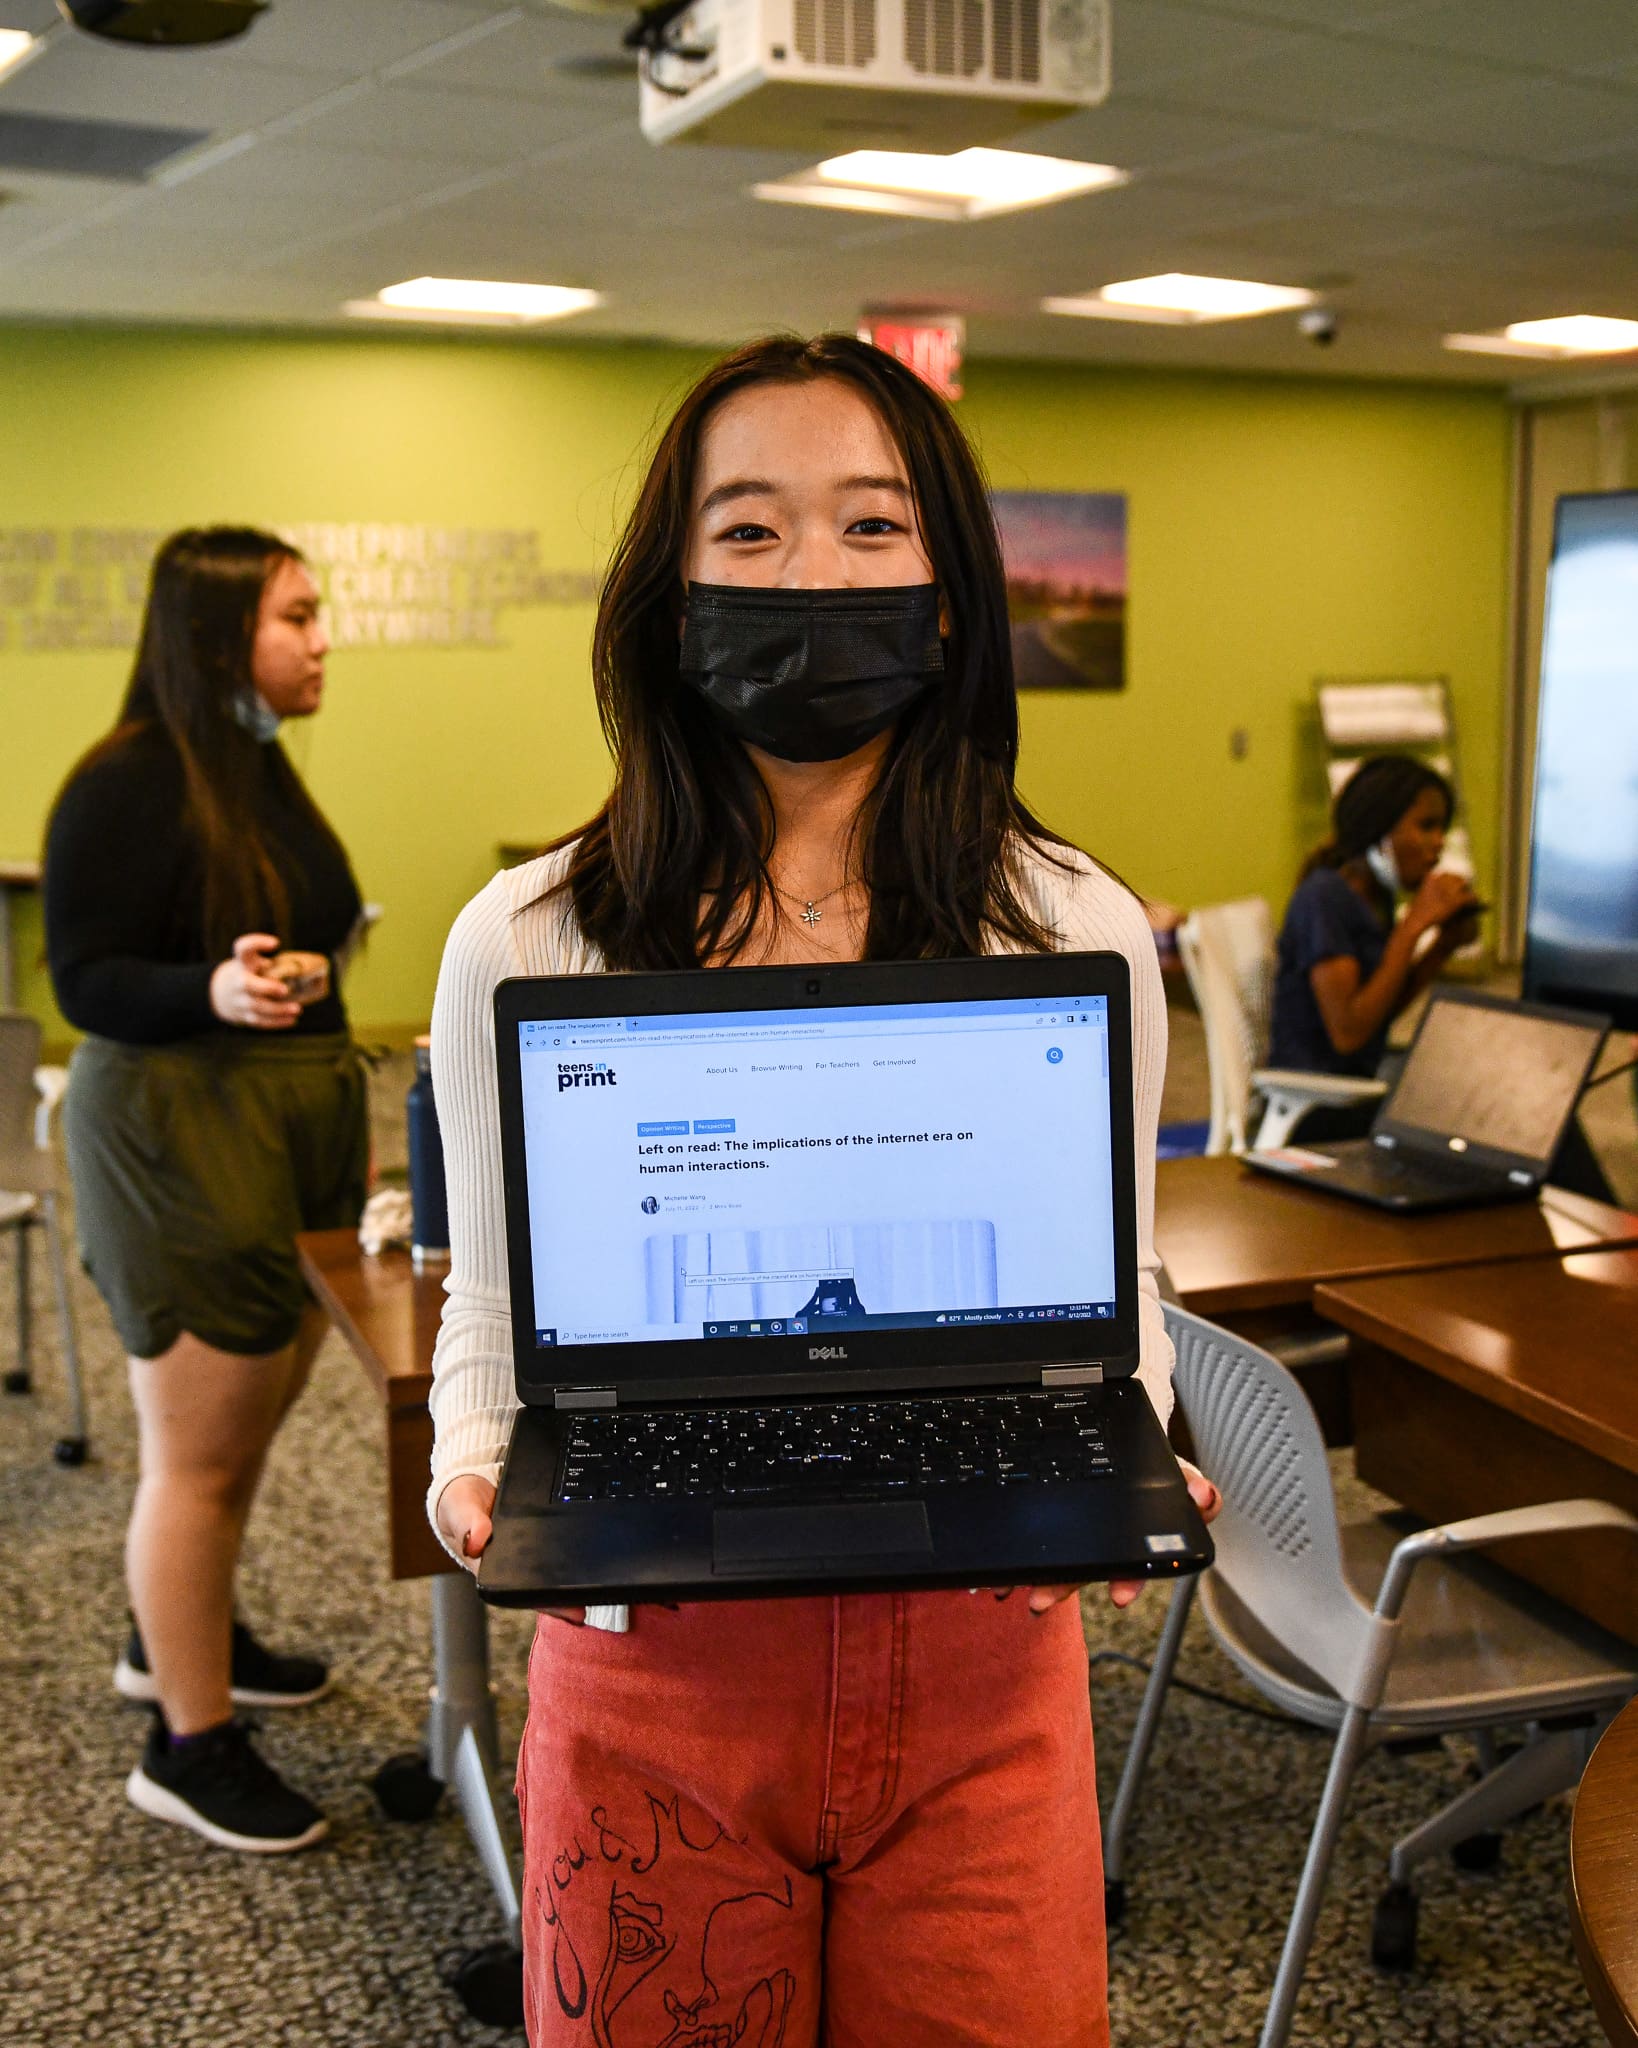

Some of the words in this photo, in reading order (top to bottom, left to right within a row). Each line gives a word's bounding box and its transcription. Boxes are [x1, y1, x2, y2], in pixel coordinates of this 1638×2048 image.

[830, 1061, 860, 1069] Teachers
[887, 1058, 917, 1066] Involved
[558, 1063, 594, 1072] teens
[595, 1062, 607, 1071] in
[706, 1066, 727, 1074] About
[779, 1064, 803, 1072] Writing
[558, 1069, 617, 1092] print
[638, 1144, 664, 1155] Left
[667, 1144, 684, 1154] on
[688, 1142, 721, 1152] read:
[724, 1140, 748, 1151] The
[753, 1137, 832, 1151] implications
[835, 1135, 849, 1146] of
[852, 1134, 874, 1145] the
[877, 1132, 929, 1144] internet
[932, 1132, 953, 1141] era
[957, 1132, 973, 1140] on
[639, 1163, 684, 1174] human
[688, 1159, 770, 1172] interactions.
[964, 1314, 983, 1322] Mostly
[983, 1313, 1002, 1321] cloudy
[808, 1346, 848, 1360] DELL
